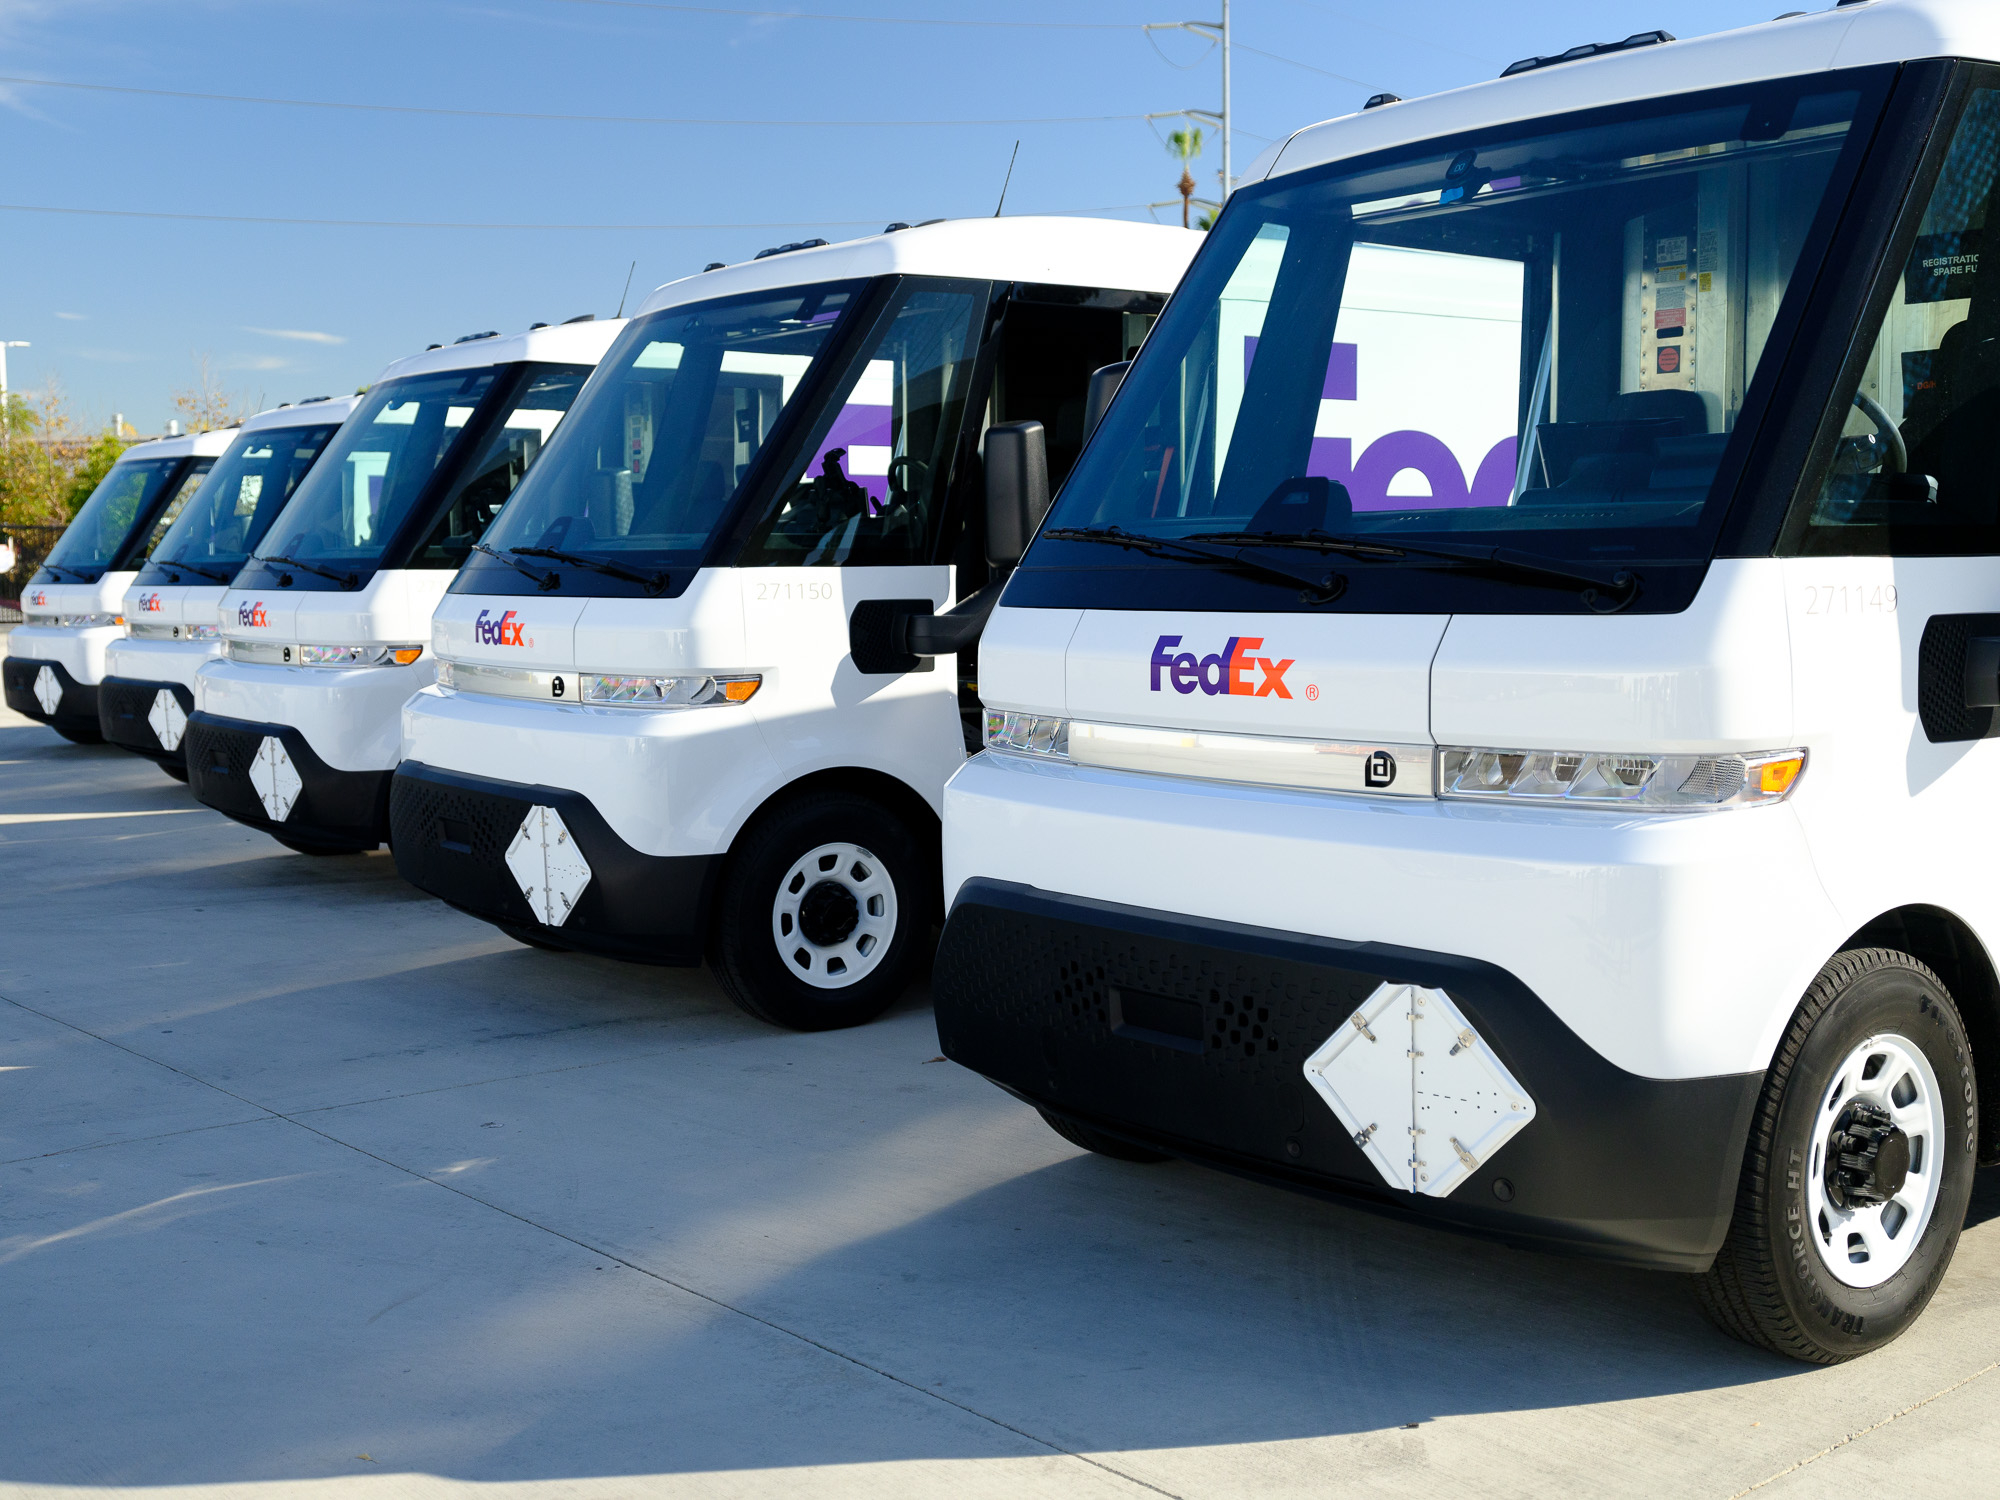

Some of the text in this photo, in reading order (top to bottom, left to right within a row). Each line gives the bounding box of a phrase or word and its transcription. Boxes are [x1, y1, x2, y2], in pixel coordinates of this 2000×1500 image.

[1933, 266, 1963, 277] SPARE
[756, 582, 833, 601] 271150
[1804, 584, 1898, 615] 271149
[238, 600, 268, 628] FedEx
[475, 609, 526, 647] FedEx
[1150, 635, 1296, 700] FedEx
[1786, 1147, 1865, 1337] TRANSFORCE HT
